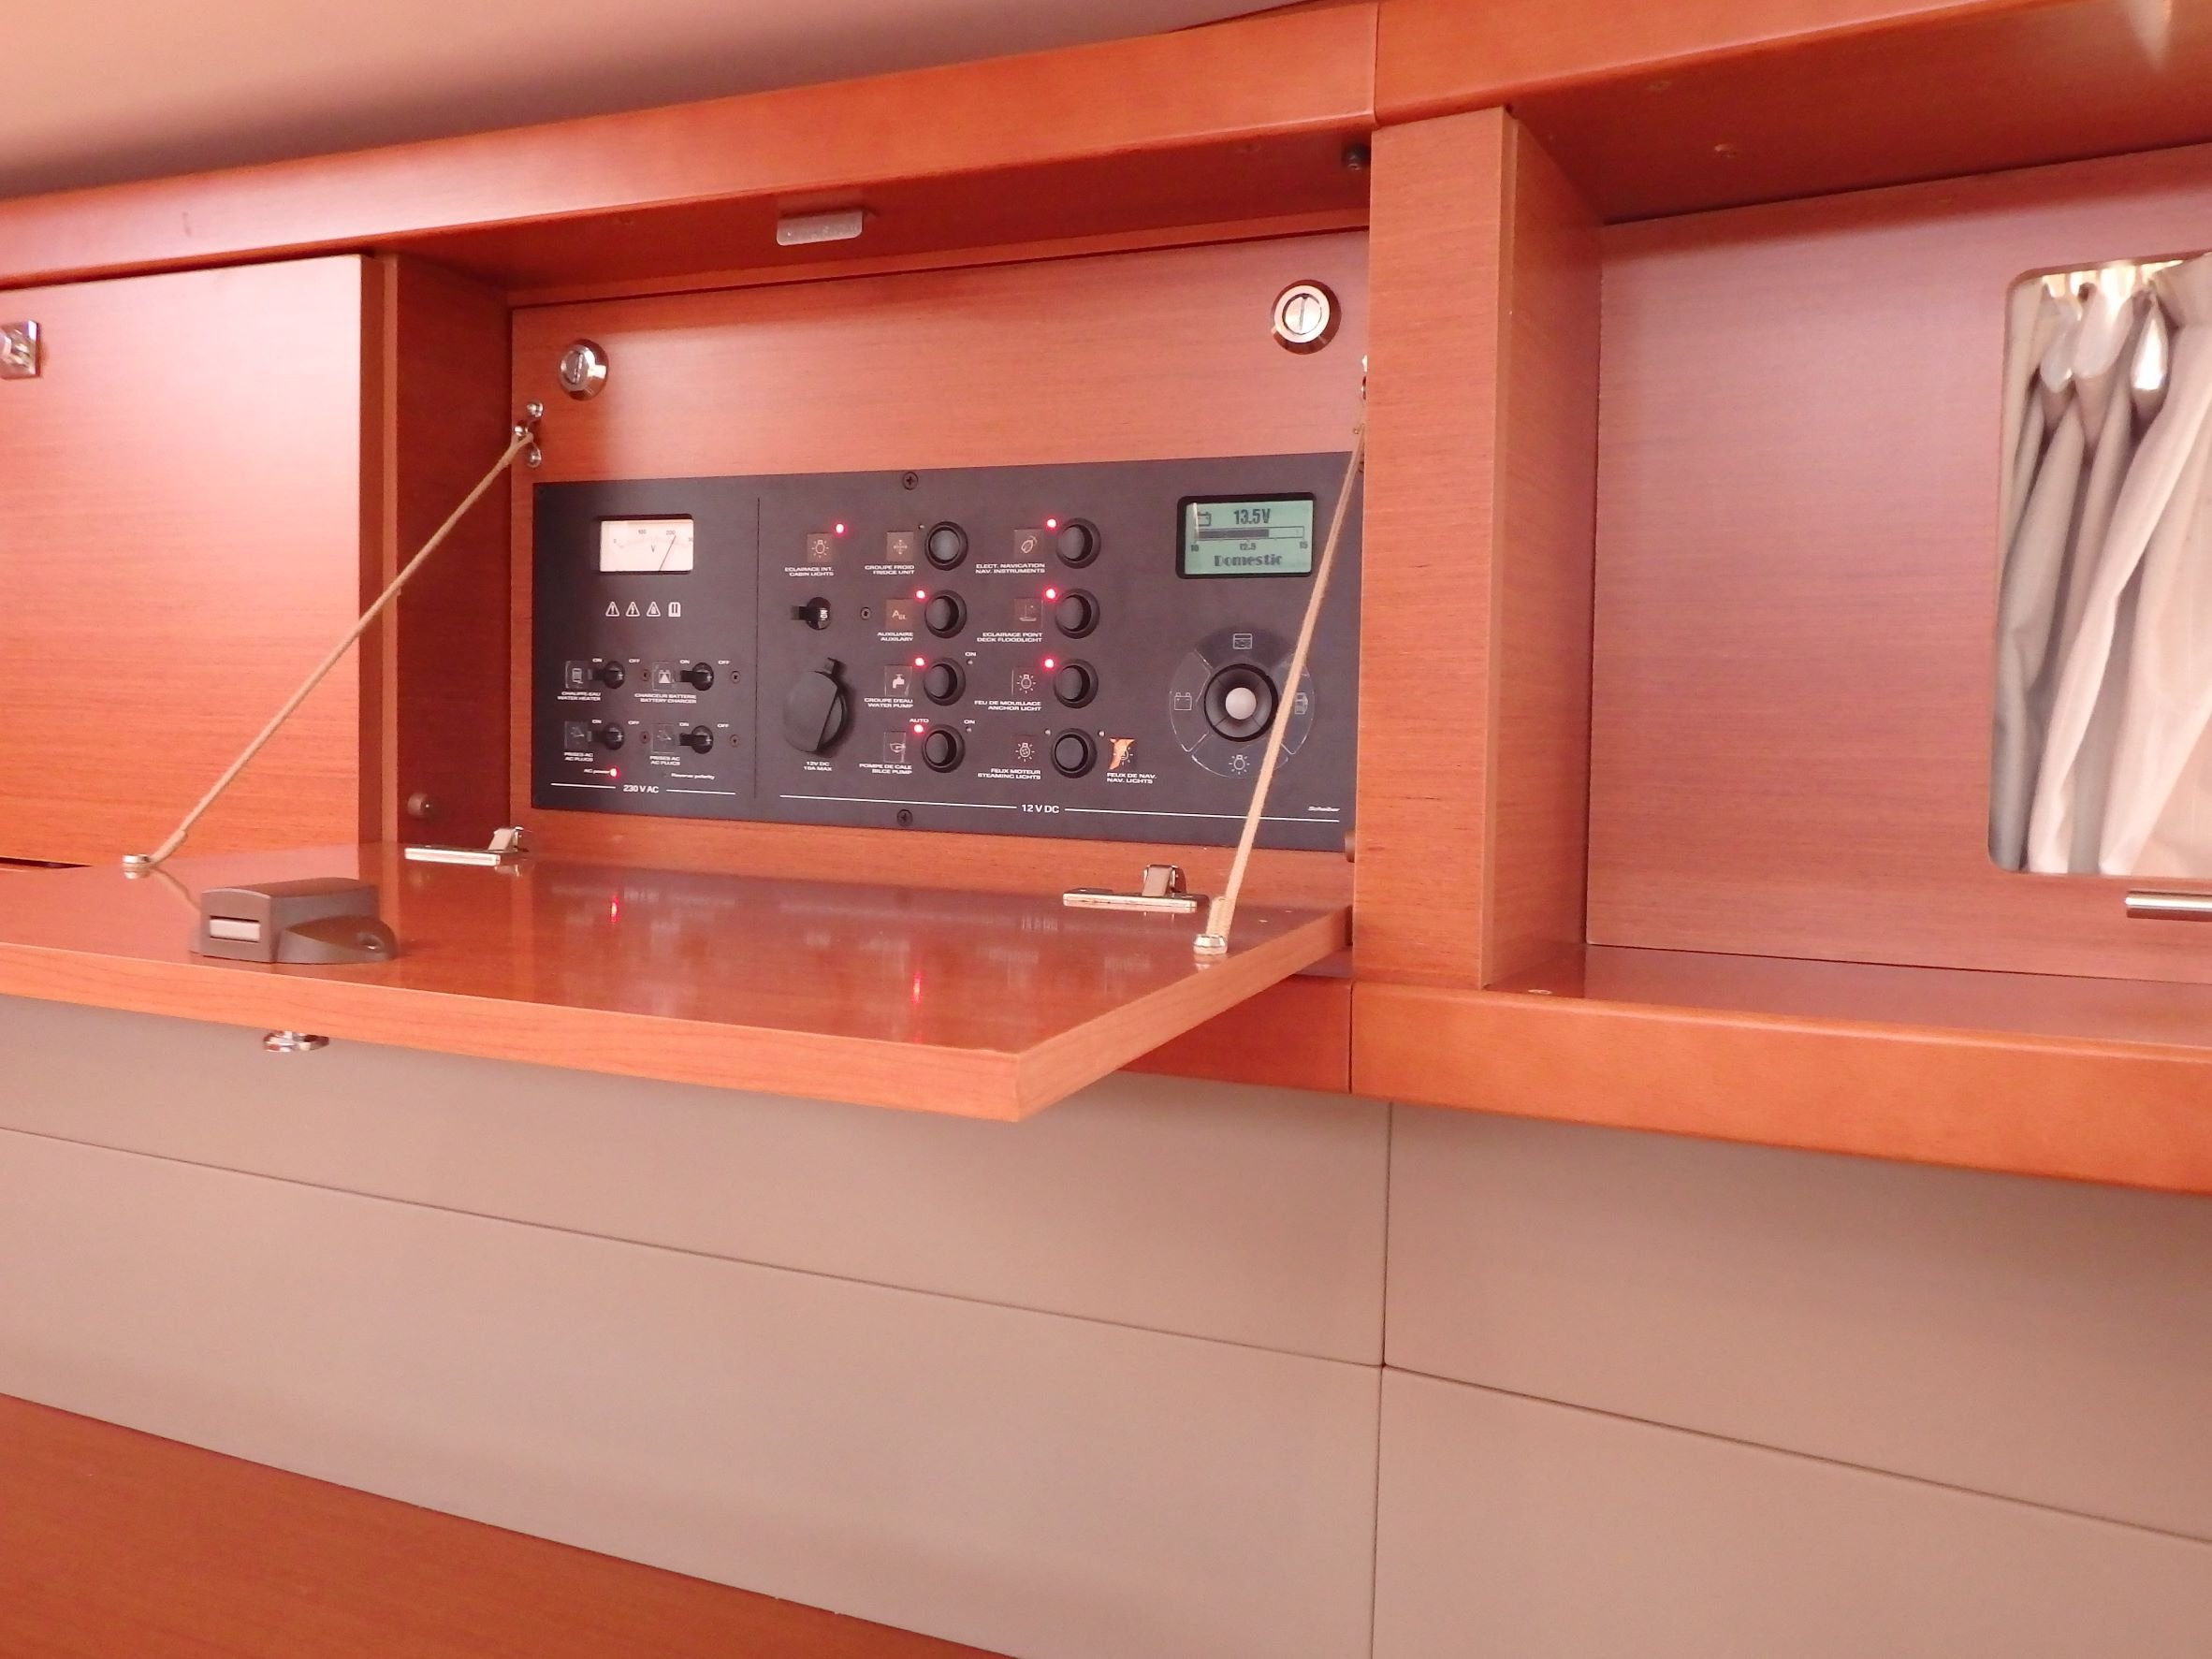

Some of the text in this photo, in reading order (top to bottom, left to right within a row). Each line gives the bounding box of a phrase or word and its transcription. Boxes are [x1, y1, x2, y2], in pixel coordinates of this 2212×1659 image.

[1233, 508, 1271, 525] 13.5V
[1214, 554, 1283, 567] Domestic
[622, 784, 639, 793] 230
[1021, 804, 1060, 814] 12 V DC
